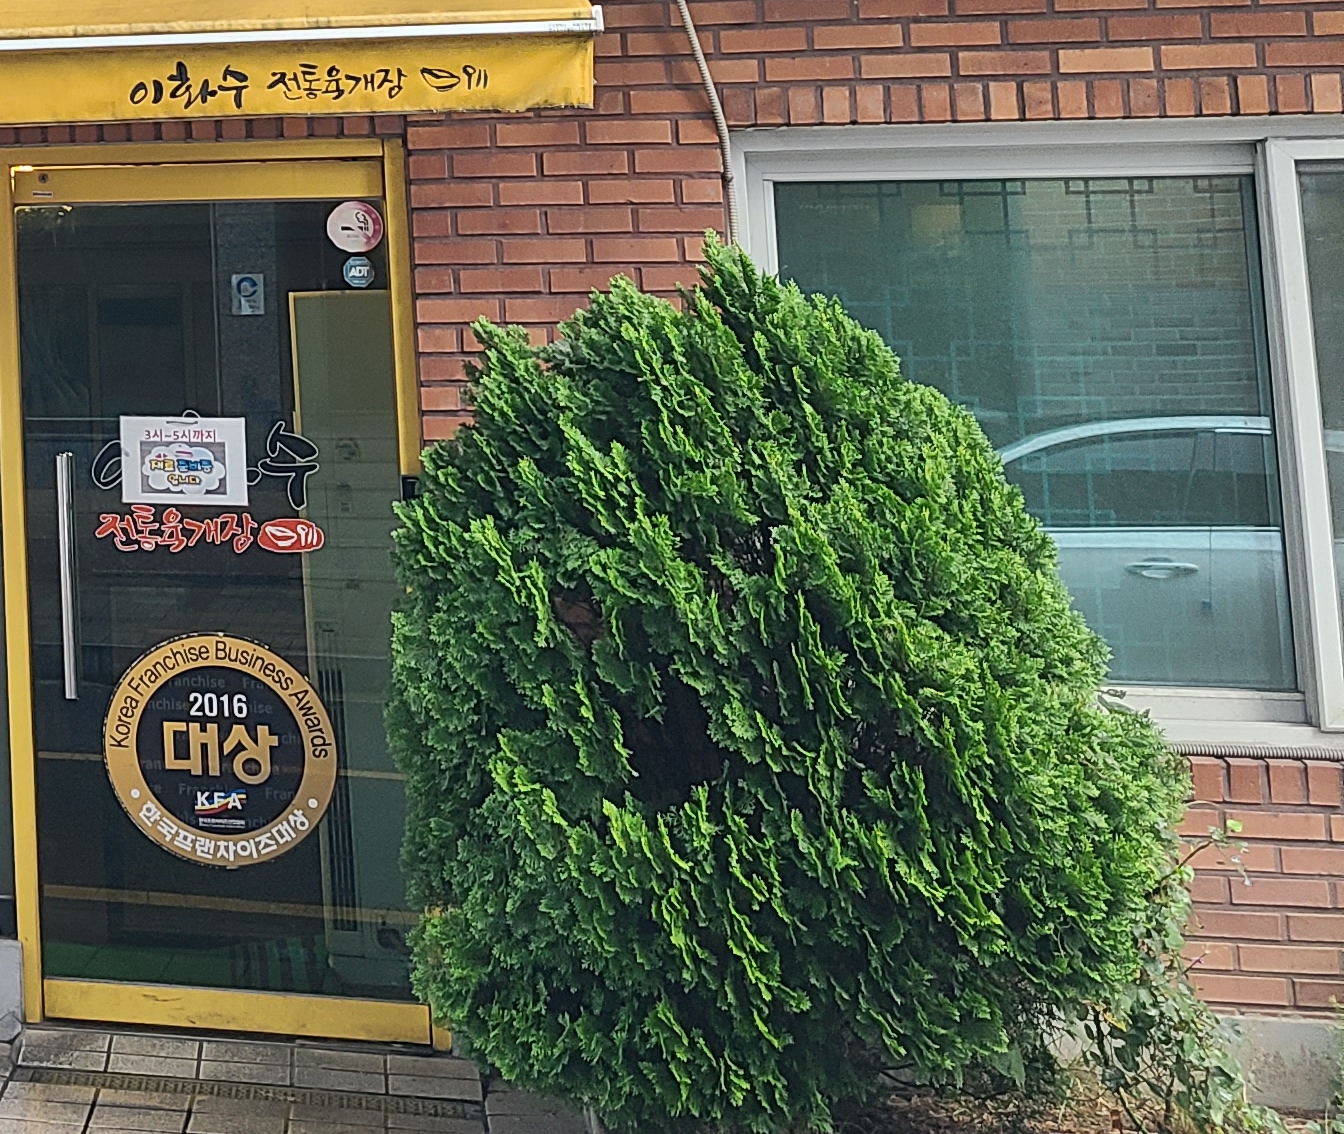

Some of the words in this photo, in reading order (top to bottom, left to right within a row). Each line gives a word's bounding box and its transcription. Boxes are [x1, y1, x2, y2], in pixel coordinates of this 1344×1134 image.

[129, 59, 250, 110] 이화수
[266, 62, 408, 101] 전통육개장
[348, 266, 370, 277] ADT
[94, 505, 258, 554] 전통육개장
[109, 694, 140, 749] Korea
[127, 643, 210, 697] Franchise
[214, 640, 294, 692] Business
[288, 689, 332, 760] Awards
[188, 691, 248, 719] 2016
[162, 721, 279, 785] 대상
[138, 800, 311, 862] 한국프랜차이즈대상
